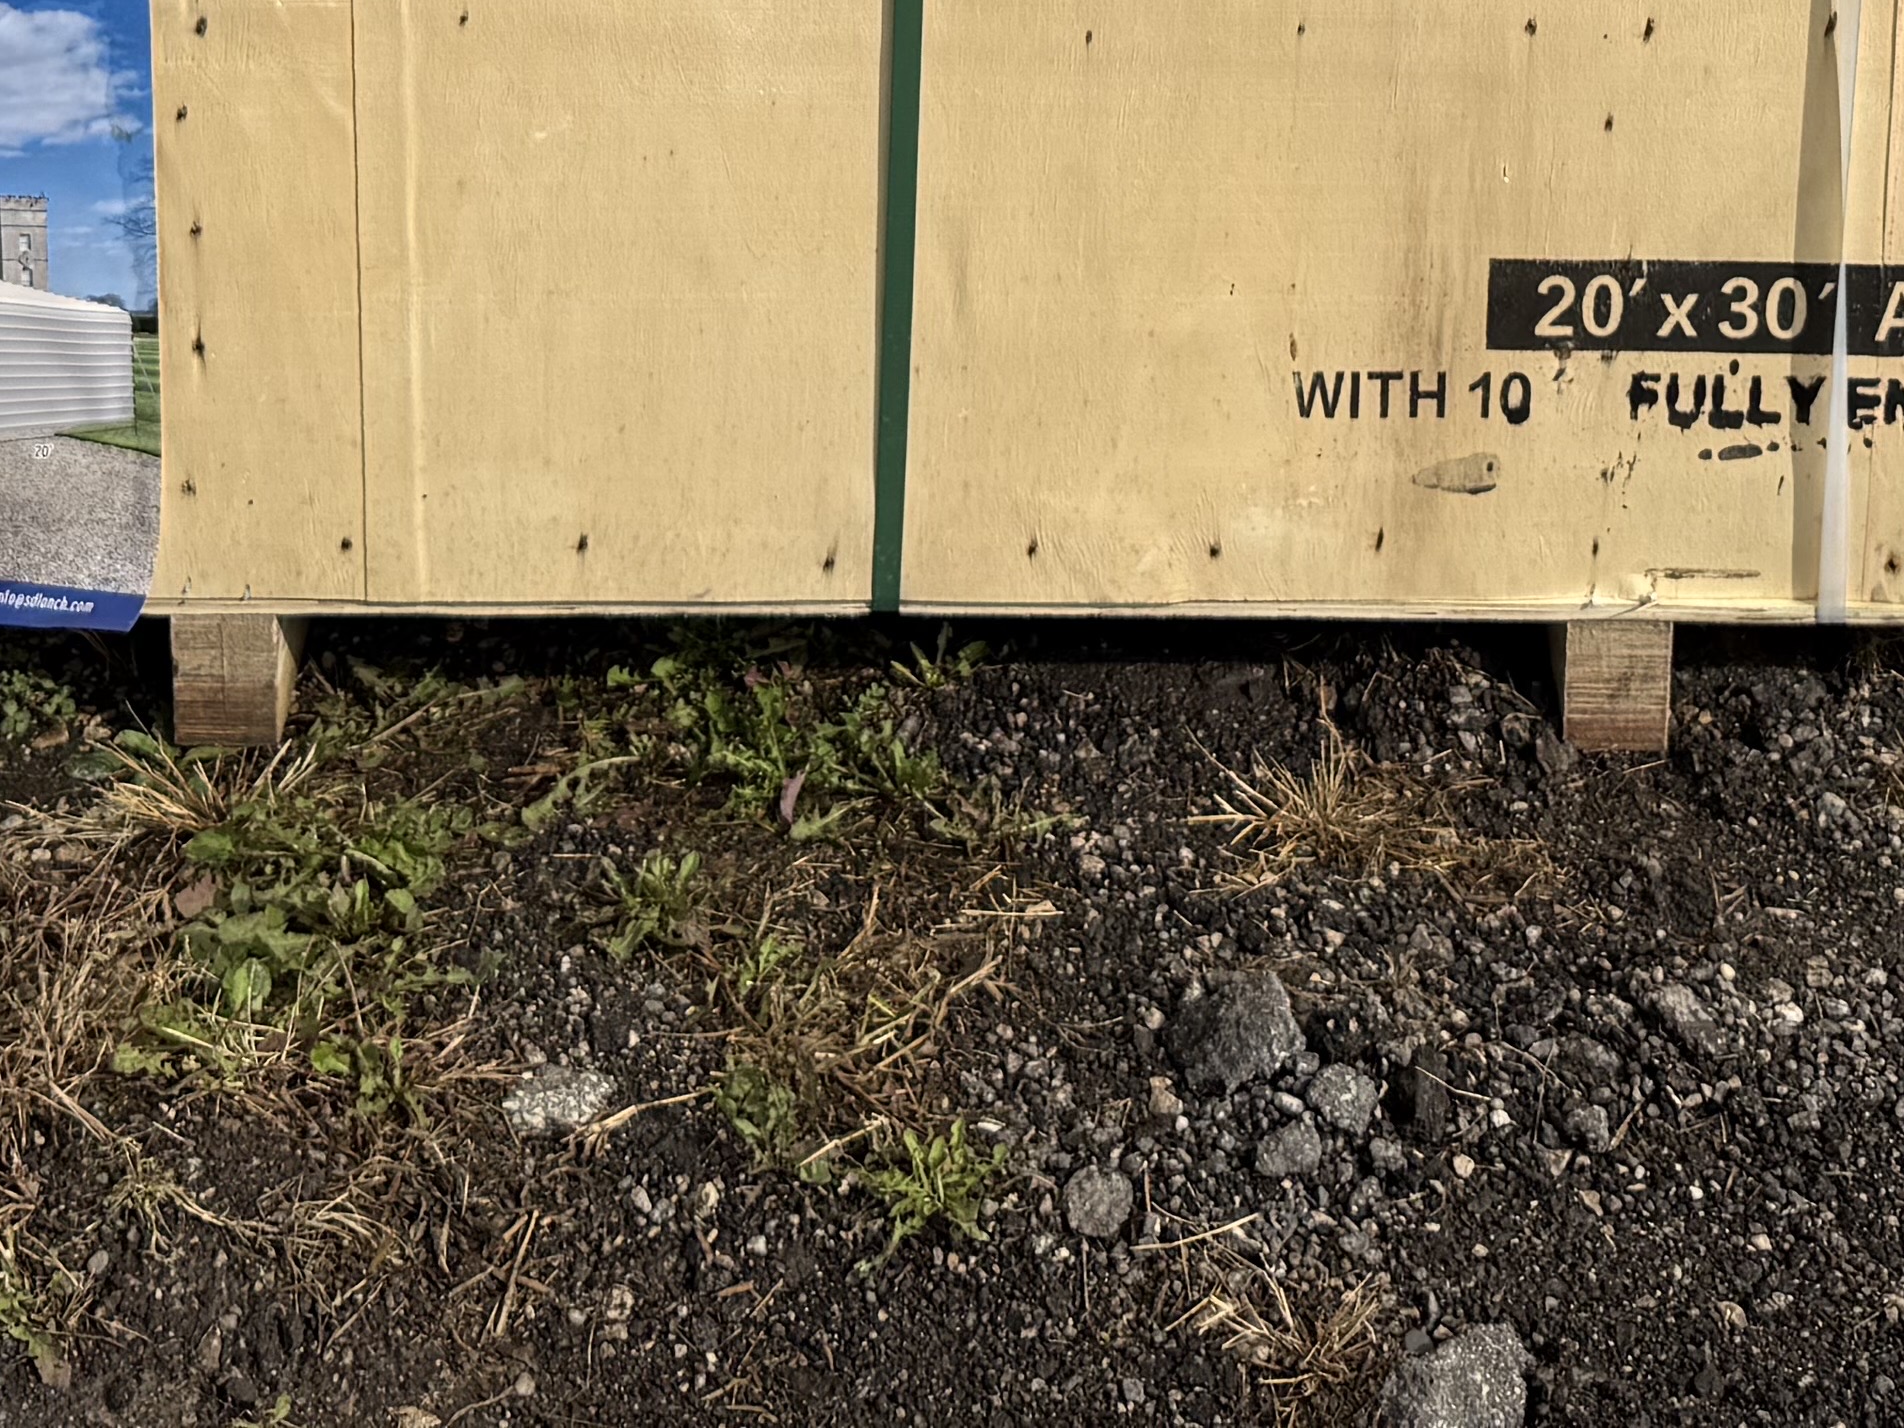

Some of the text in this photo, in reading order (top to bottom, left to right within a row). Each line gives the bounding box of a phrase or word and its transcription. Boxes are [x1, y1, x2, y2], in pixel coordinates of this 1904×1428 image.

[1656, 293, 1700, 338] x
[1293, 370, 1446, 419] WITH
[1628, 370, 1827, 429] FULLY
[33, 443, 53, 459] 20'
